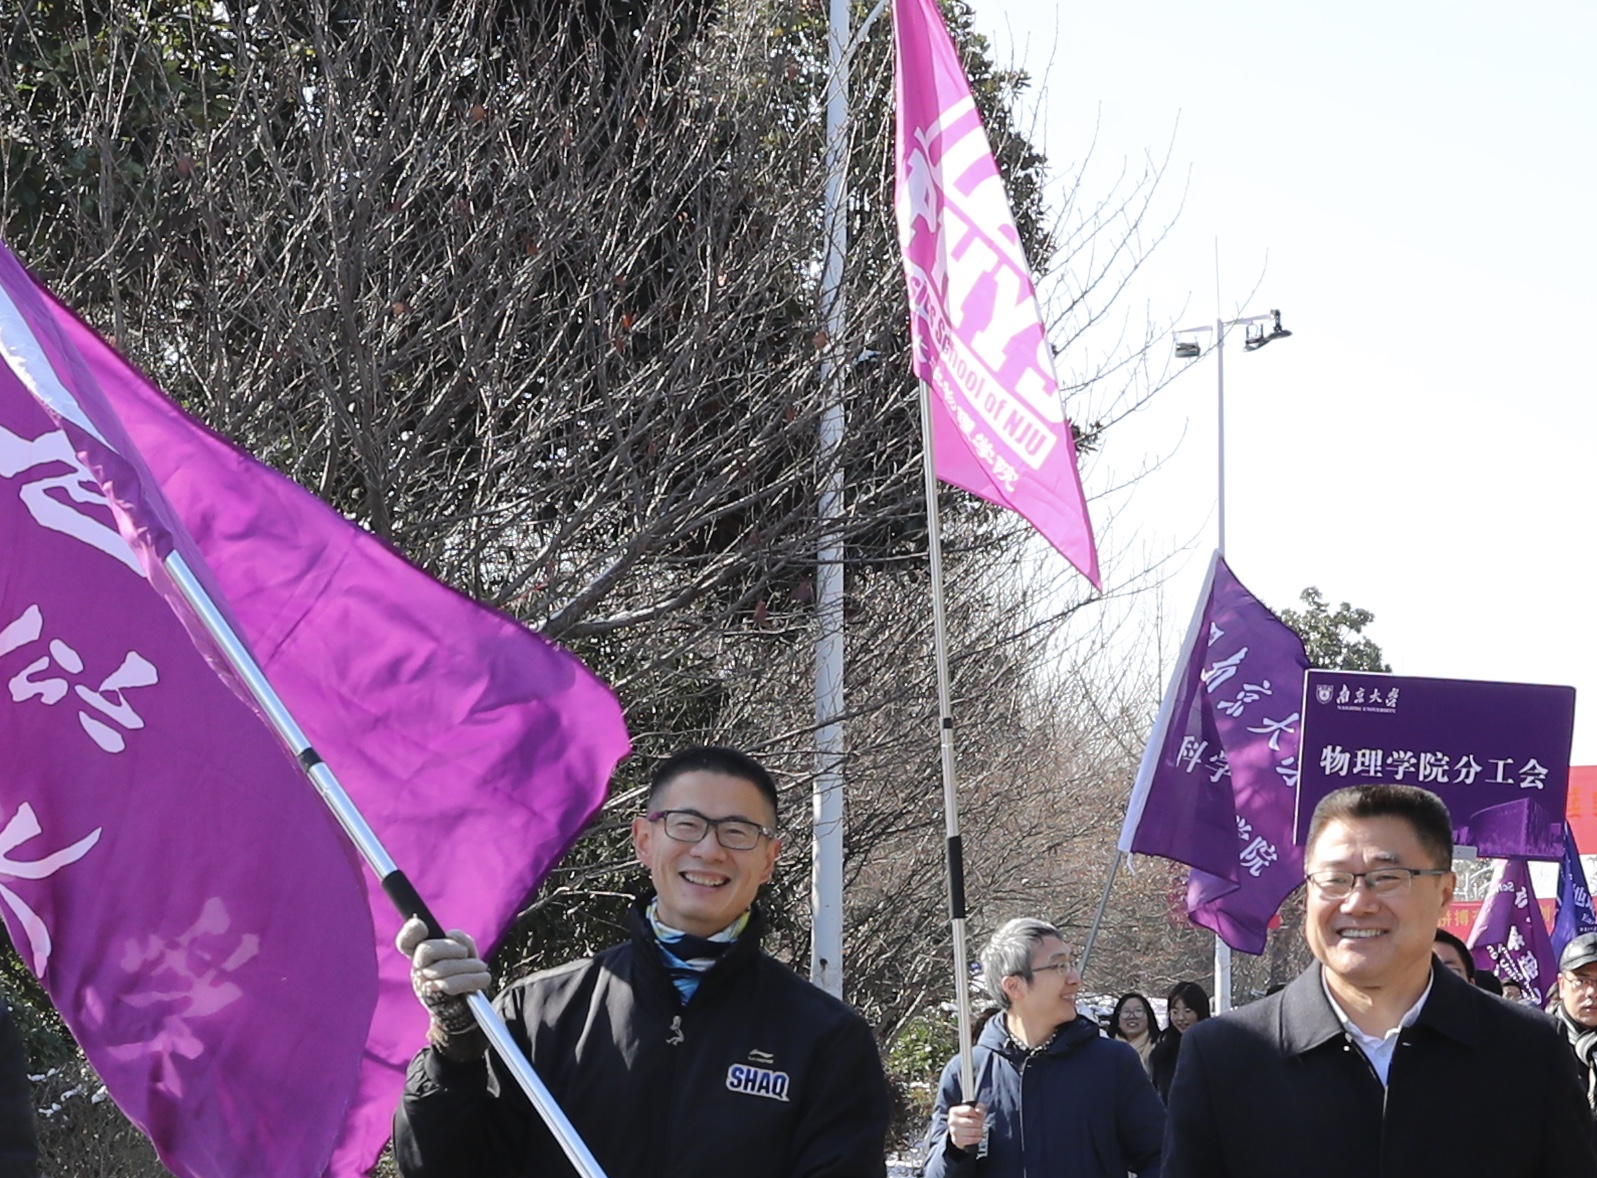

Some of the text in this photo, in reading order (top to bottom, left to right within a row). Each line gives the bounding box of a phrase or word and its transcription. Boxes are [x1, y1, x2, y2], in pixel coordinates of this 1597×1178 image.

[983, 390, 1007, 421] of
[1001, 407, 1049, 458] NJU
[1319, 744, 1549, 790] 物理学院分工会
[726, 1063, 790, 1102] SHAQ
